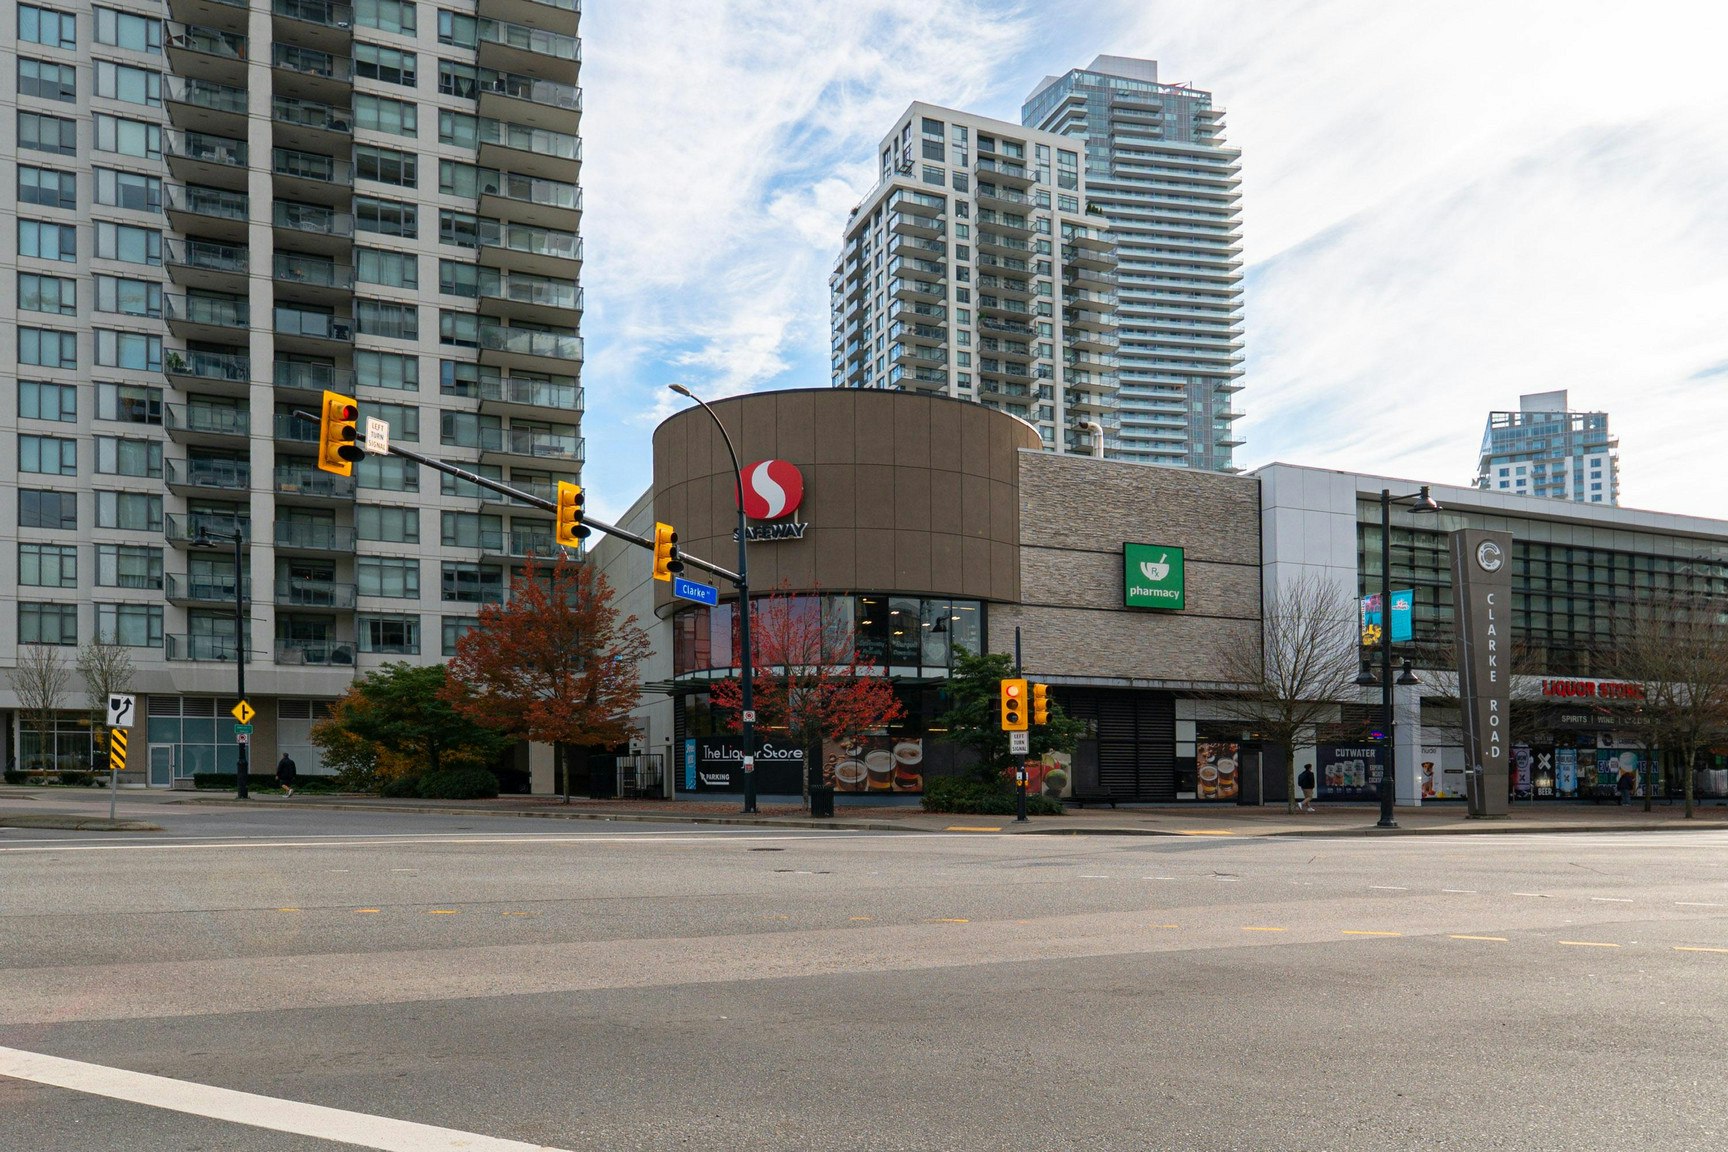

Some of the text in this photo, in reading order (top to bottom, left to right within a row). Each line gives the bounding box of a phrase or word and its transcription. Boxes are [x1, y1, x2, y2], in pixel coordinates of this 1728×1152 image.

[371, 422, 384, 432] LEFT
[370, 431, 384, 440] TURN
[368, 439, 386, 450] SIGNAL
[682, 584, 706, 599] Clarke
[1130, 585, 1180, 600] pharmacy
[1487, 593, 1500, 757] CLARKE ROAD
[1541, 679, 1596, 698] LIQUOR
[1561, 715, 1588, 723] SPIRITS
[1597, 716, 1615, 724] WINE
[703, 745, 721, 759] The
[722, 745, 761, 760] Liqur
[763, 743, 804, 758] Store
[1335, 748, 1376, 757] CUTWATER
[706, 773, 730, 781] PARKING
